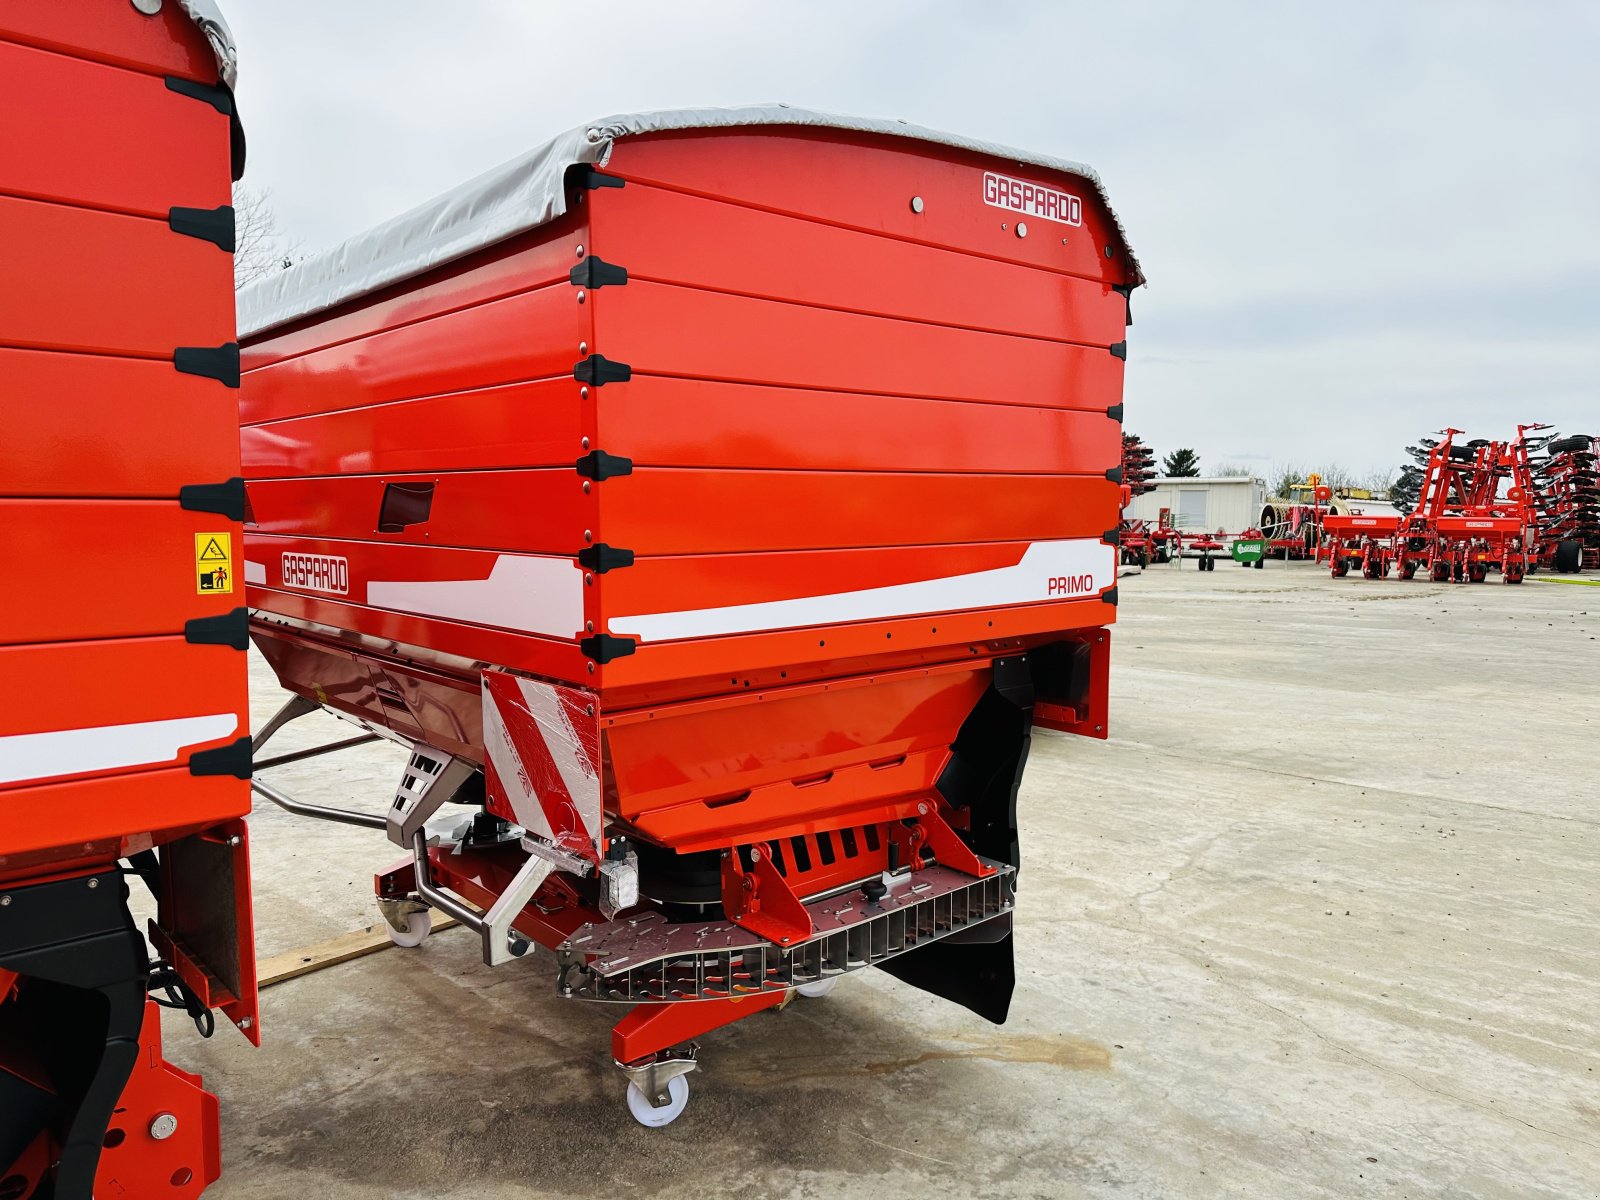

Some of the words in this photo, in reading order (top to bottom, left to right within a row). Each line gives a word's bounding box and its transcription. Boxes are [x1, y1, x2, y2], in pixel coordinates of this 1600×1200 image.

[984, 174, 1080, 224] GASPARDO
[283, 555, 348, 592] GASPARDO
[1048, 574, 1093, 595] PRIMO
